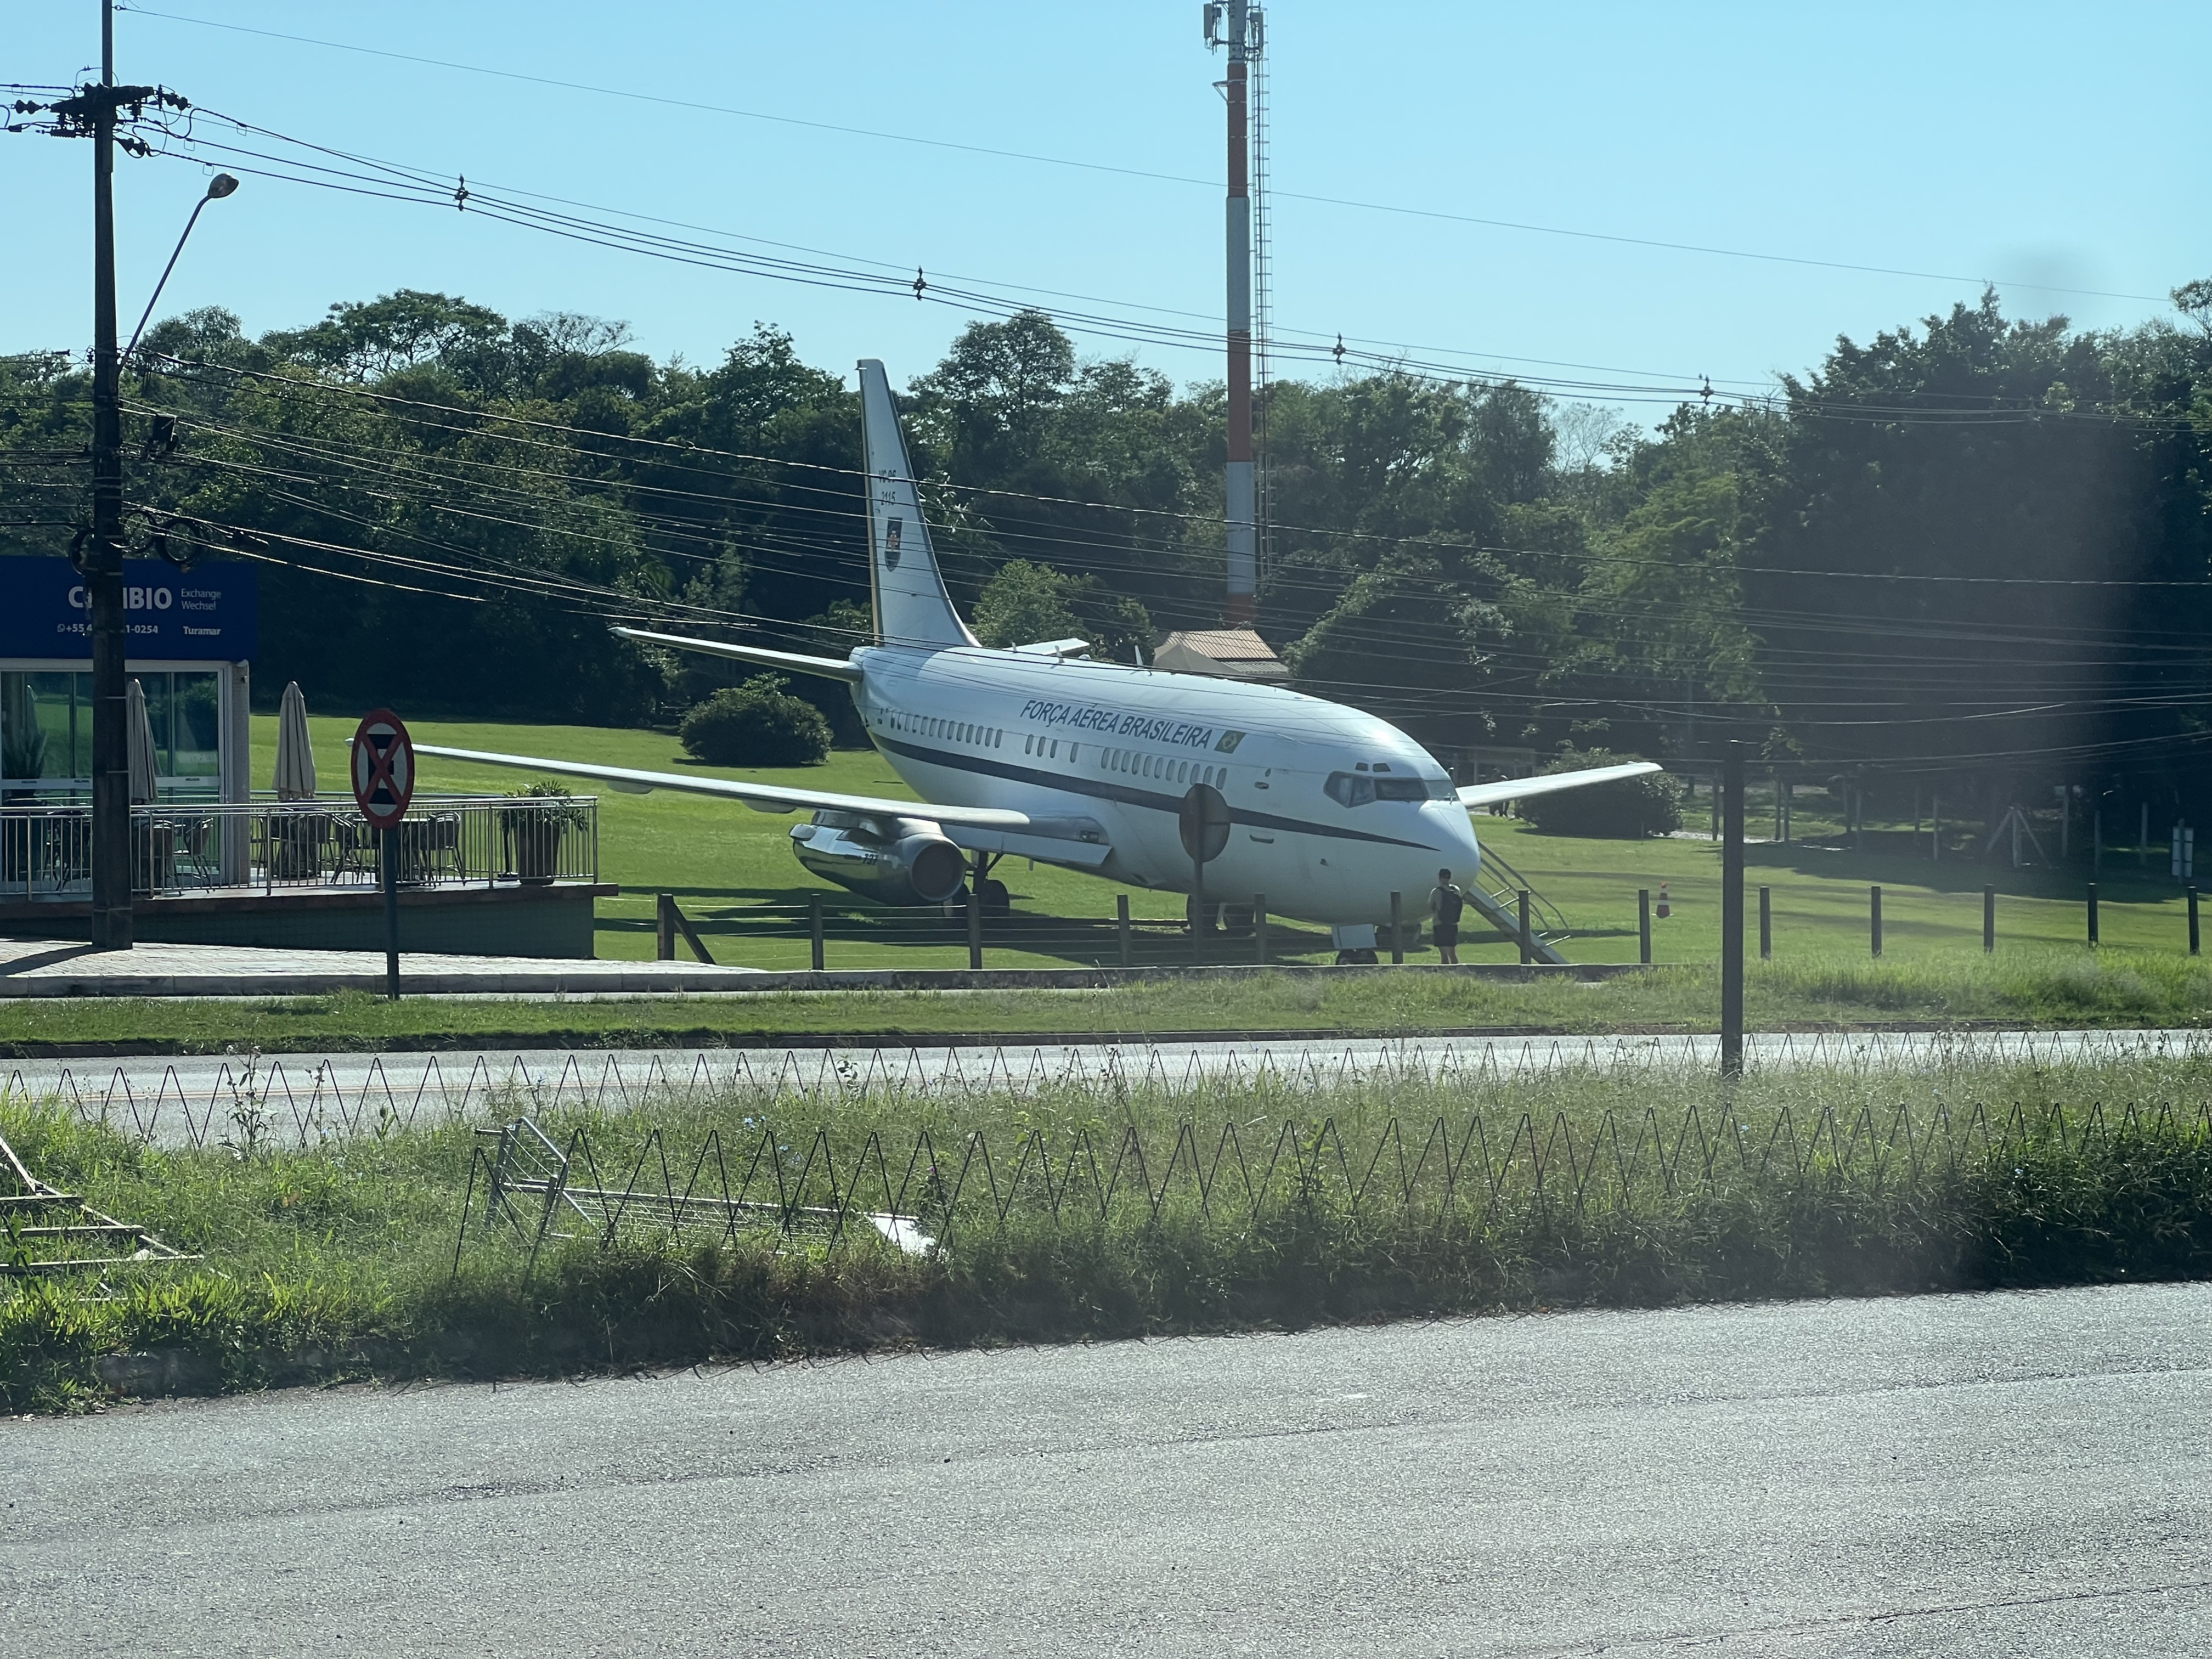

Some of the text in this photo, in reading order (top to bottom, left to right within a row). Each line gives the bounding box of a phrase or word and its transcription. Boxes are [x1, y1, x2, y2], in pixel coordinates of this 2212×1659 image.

[881, 491, 895, 506] 2115
[69, 586, 172, 610] CBIO
[181, 588, 221, 600] Exchange
[181, 600, 216, 611] Wechsel
[183, 626, 221, 635] Turamar
[1020, 699, 1213, 749] FORÇA AÉREA BRASILEIRA
[862, 853, 879, 866] 737
